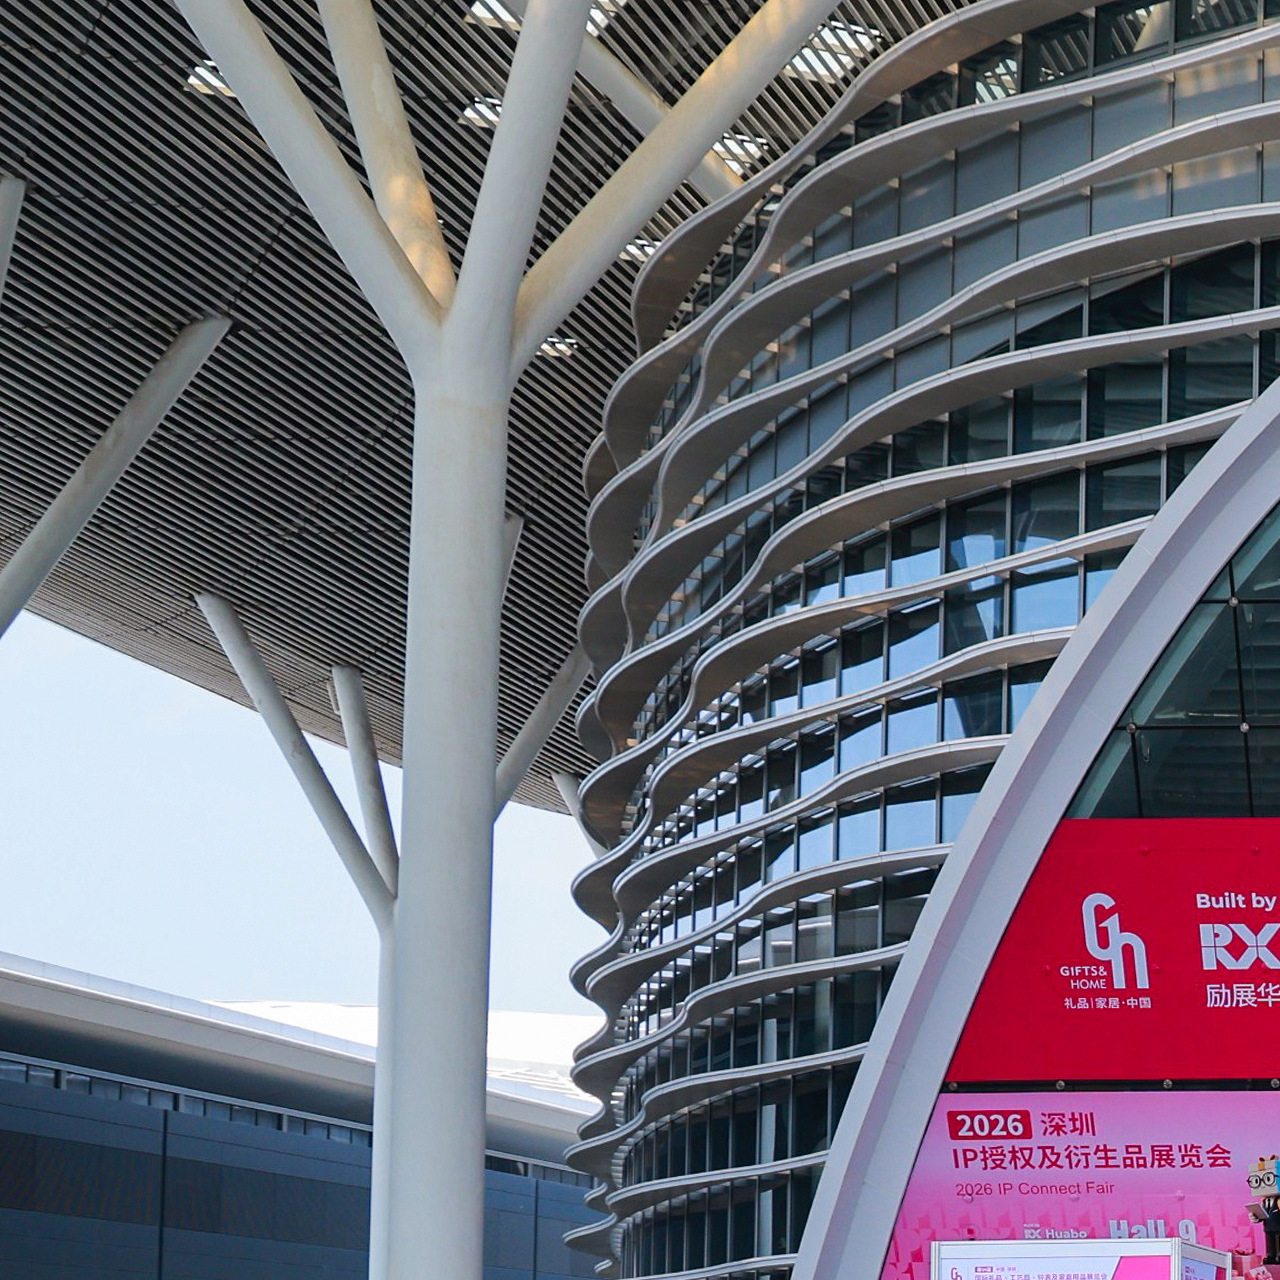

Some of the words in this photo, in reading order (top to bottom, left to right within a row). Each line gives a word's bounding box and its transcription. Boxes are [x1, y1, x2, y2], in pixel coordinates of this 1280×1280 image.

[1196, 892, 1247, 909] Built
[1251, 892, 1277, 911] by
[1070, 979, 1106, 990] HOME
[956, 1114, 1024, 1137] 2026
[1040, 1112, 1097, 1137] 深圳
[952, 1143, 1232, 1171] IP授权及衍生品展览会
[956, 1183, 993, 1197] 2026
[998, 1182, 1013, 1196] IP
[1018, 1181, 1080, 1196] Connect
[1086, 1181, 1115, 1195] Fair
[1046, 1229, 1088, 1239] Huabo
[1109, 1219, 1167, 1239] Hall
[1178, 1219, 1197, 1244] 9
